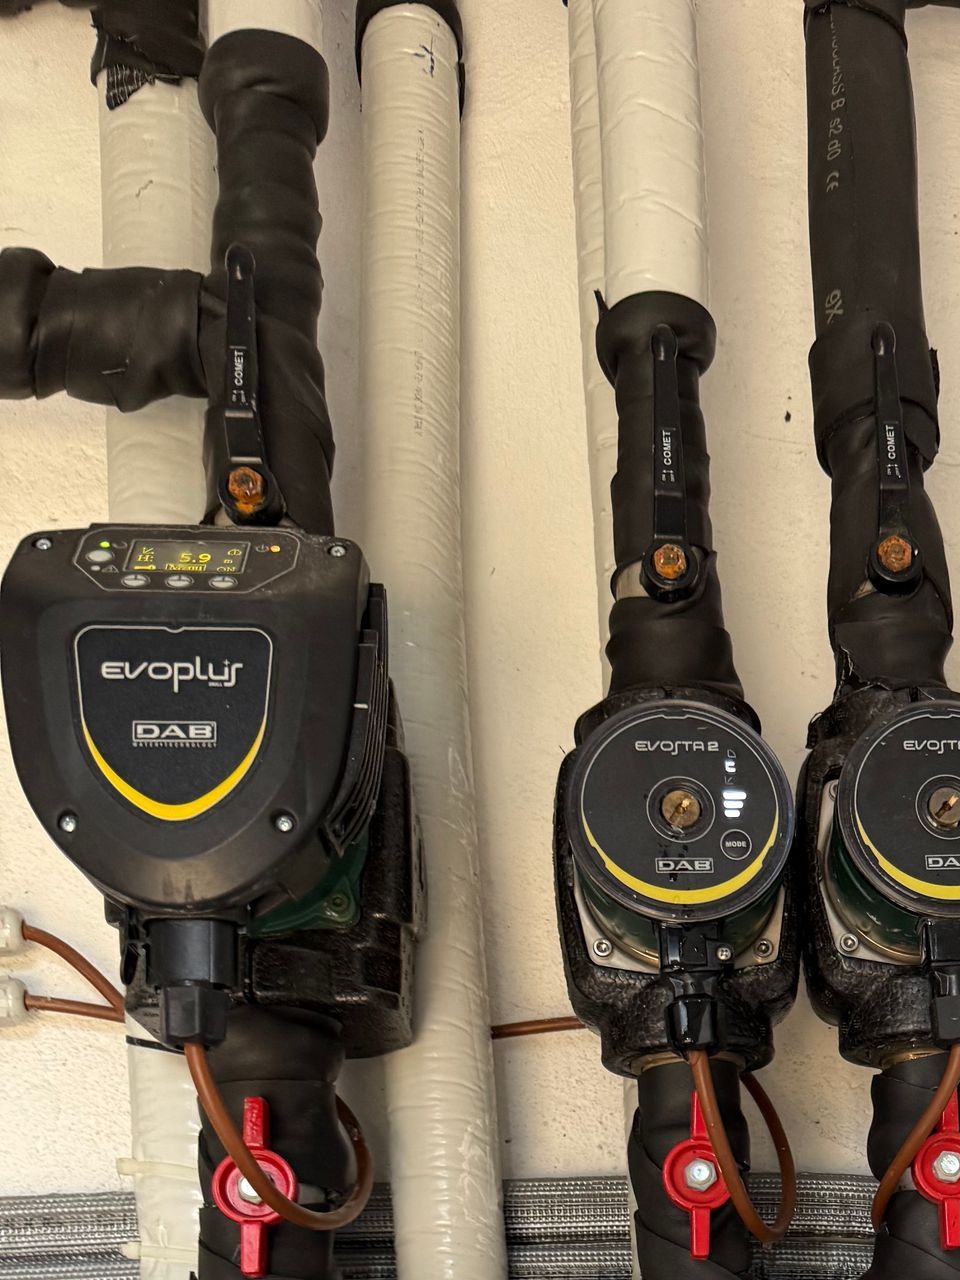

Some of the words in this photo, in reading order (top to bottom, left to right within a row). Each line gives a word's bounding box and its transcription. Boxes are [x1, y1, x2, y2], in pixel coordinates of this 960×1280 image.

[234, 349, 244, 386] COMET
[662, 429, 672, 466] COMET
[885, 424, 896, 460] COMET
[179, 552, 212, 564] 5.9
[135, 723, 213, 739] DAB
[634, 740, 705, 755] EVOSTA
[707, 741, 719, 751] 2
[725, 840, 747, 848] MODE
[658, 860, 712, 871] DAB
